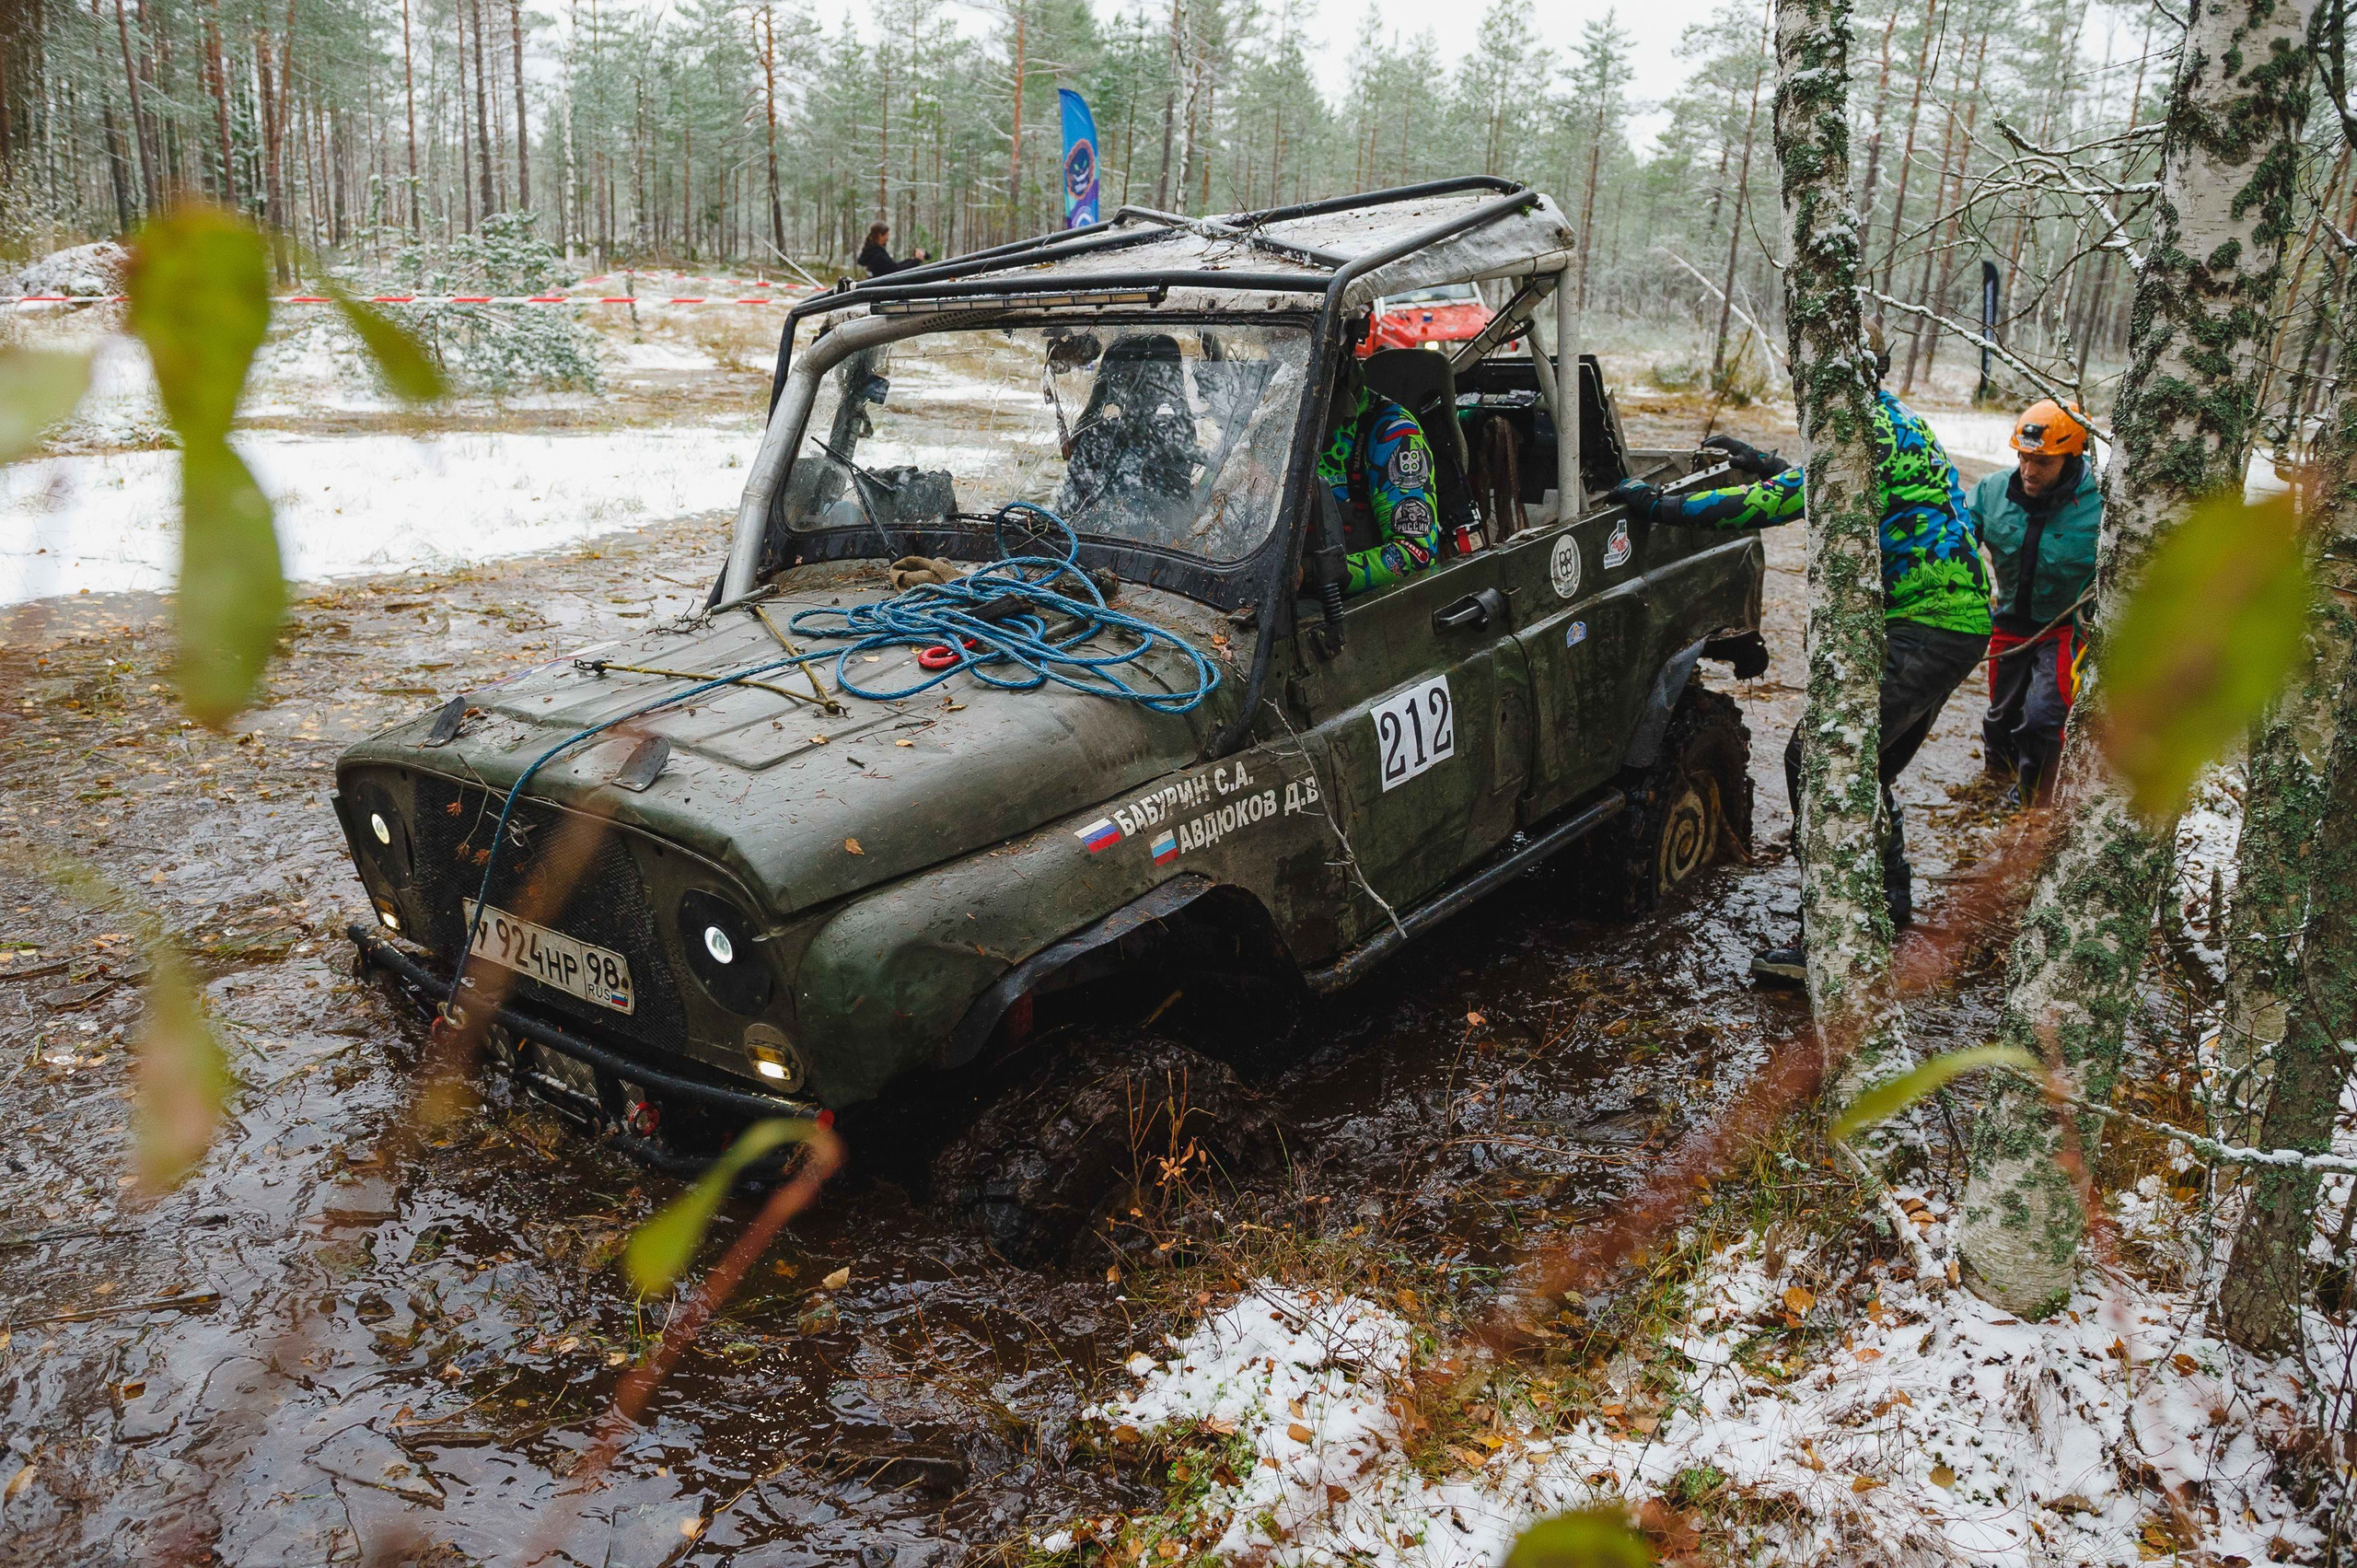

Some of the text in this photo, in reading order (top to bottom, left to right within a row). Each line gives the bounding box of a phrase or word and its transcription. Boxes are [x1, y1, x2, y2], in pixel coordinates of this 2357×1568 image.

[1397, 521, 1430, 533] РОССИИ
[1379, 686, 1452, 783] 212
[1113, 761, 1254, 837] БАБУРИН С.А.
[1178, 789, 1278, 854] АВДЮКОВ
[587, 983, 611, 1001] RUS
